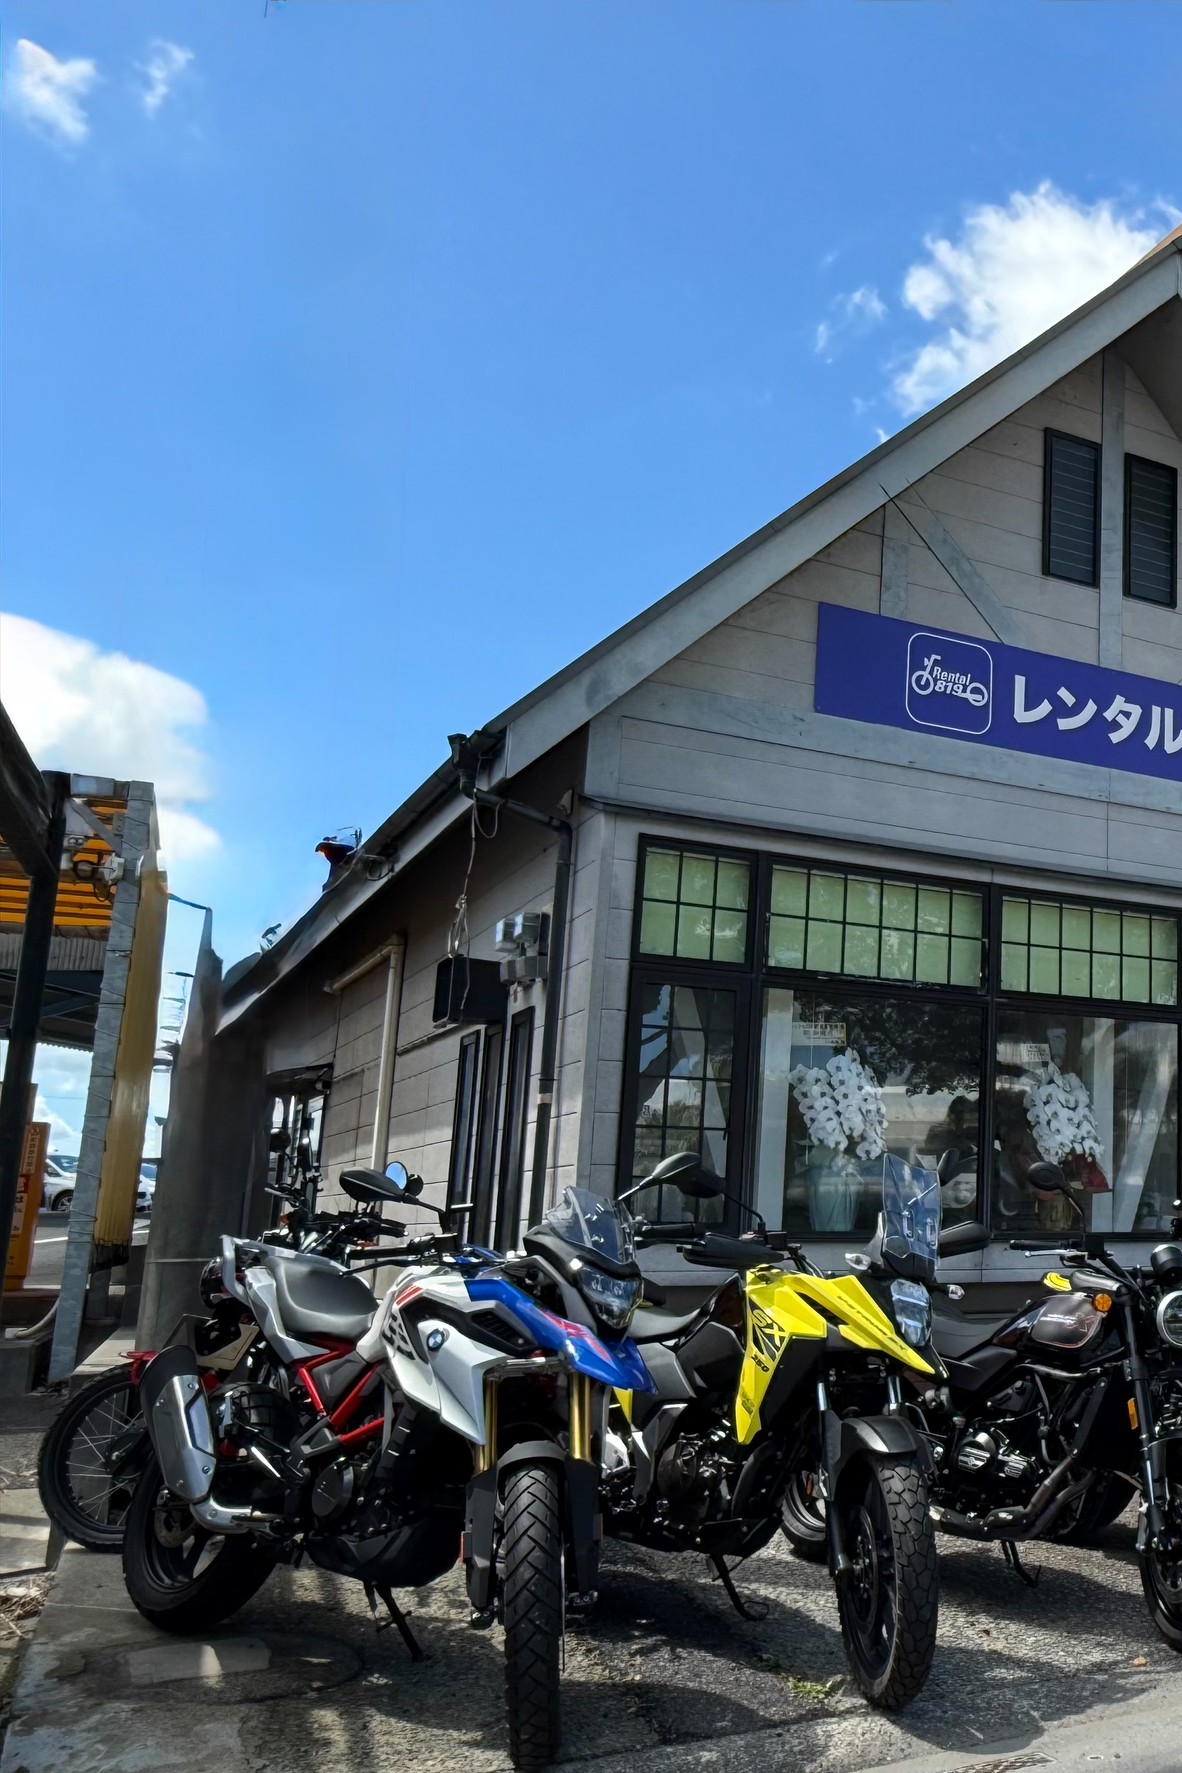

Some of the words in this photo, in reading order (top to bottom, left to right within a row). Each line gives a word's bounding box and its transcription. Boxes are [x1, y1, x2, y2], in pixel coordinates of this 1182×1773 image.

[933, 666, 971, 686] Rental
[934, 680, 963, 696] 819
[752, 1309, 789, 1348] SX
[750, 1354, 770, 1373] 250
